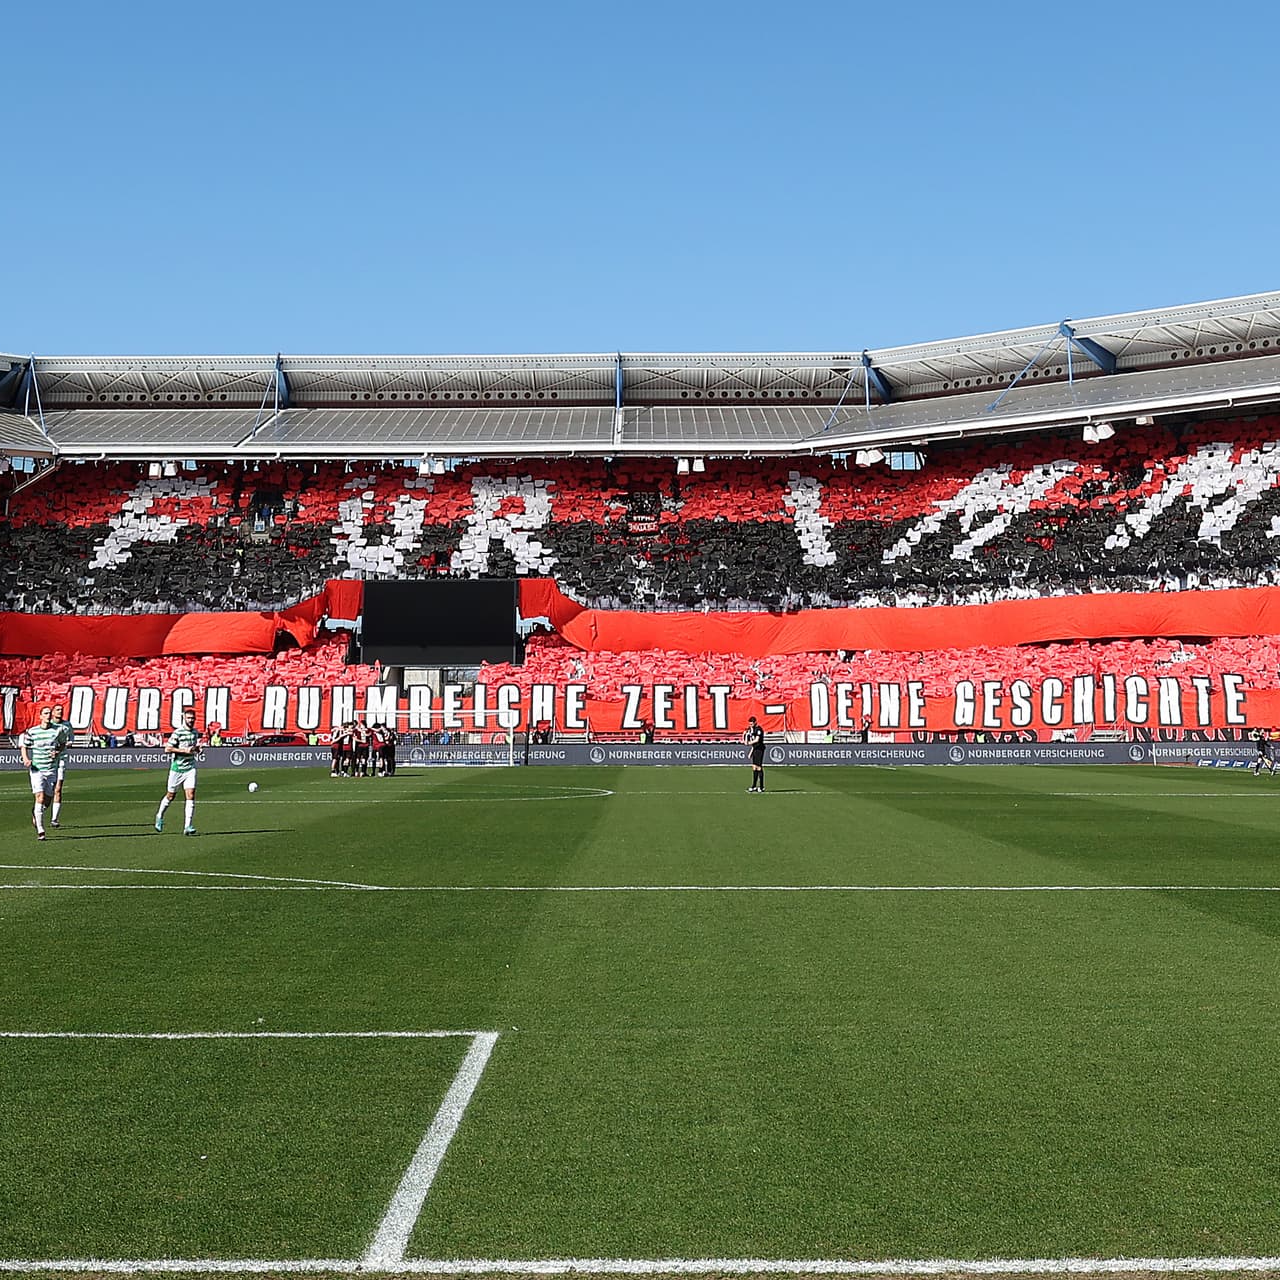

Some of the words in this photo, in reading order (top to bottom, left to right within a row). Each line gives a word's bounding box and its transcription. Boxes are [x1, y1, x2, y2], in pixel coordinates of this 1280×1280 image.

[69, 684, 229, 730] DURCH
[263, 683, 587, 730] RUHMREICHE
[622, 683, 732, 729] ZEIT
[810, 681, 926, 728] DEINE
[953, 673, 1247, 728] GESCHICHTE
[69, 752, 132, 763] NÜRNBERGER
[249, 752, 314, 762] NÜRNBERGER
[608, 749, 672, 759] NÜRNBERGER
[673, 750, 746, 759] VERSICHERUNG
[788, 749, 852, 759] NÜRNBERGER
[853, 749, 925, 759] VERSICHERUNG
[968, 748, 1032, 758] NÜRNBERGER
[1033, 749, 1105, 759] VERSICHERUNG
